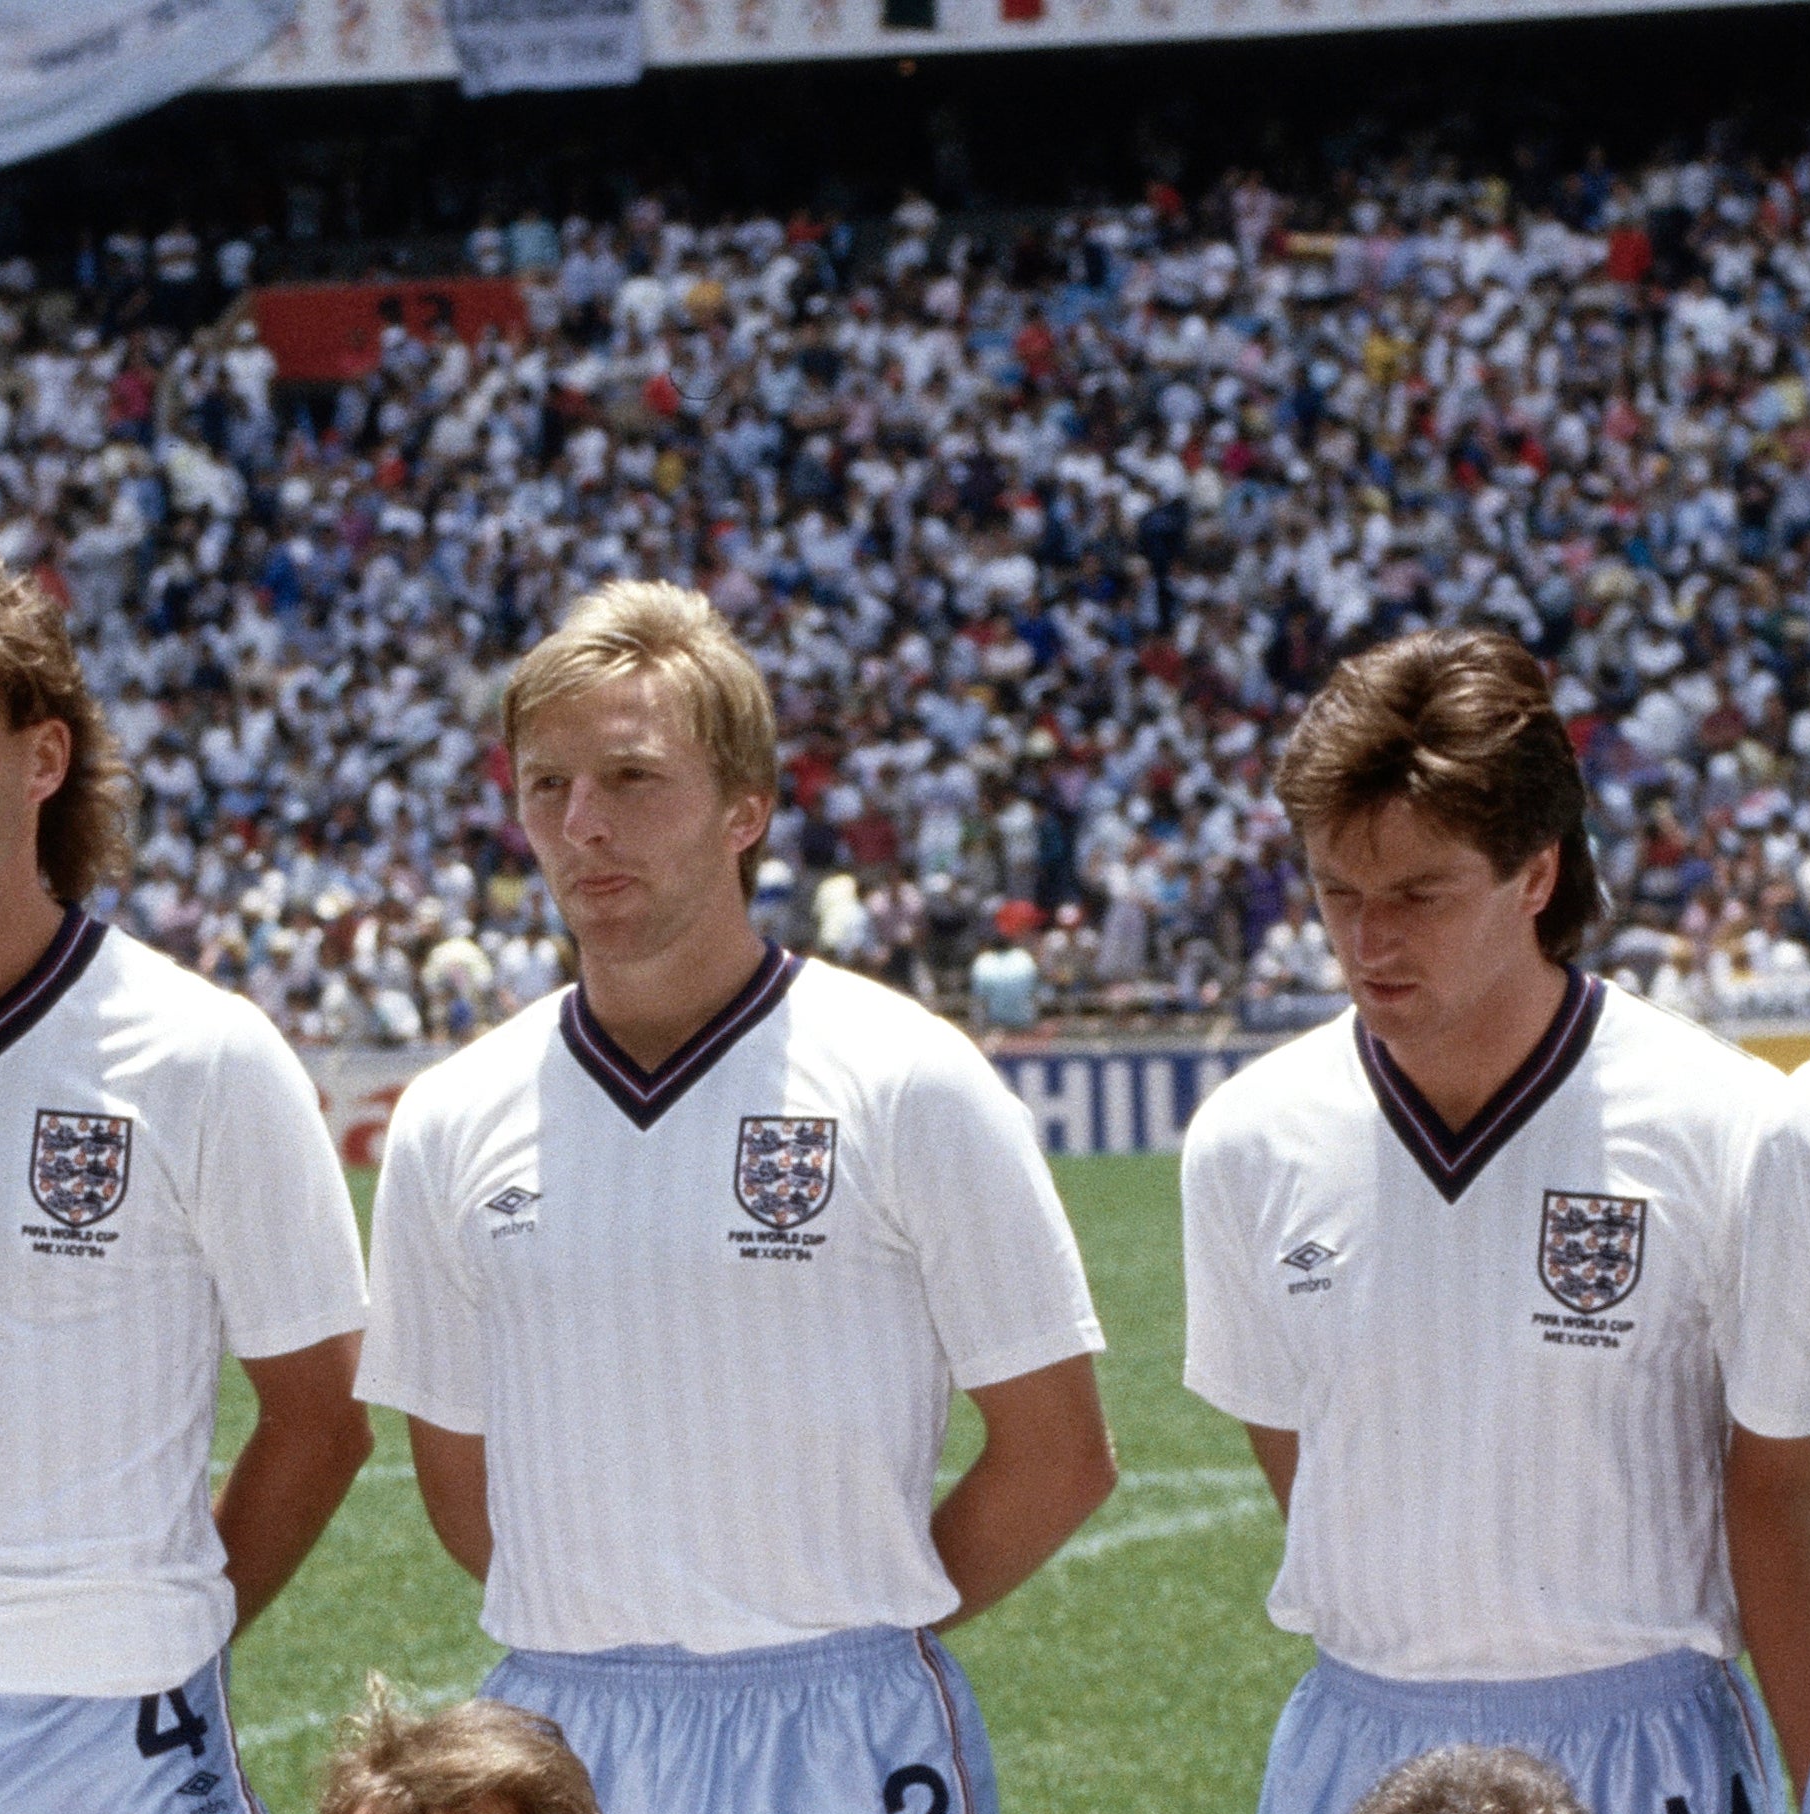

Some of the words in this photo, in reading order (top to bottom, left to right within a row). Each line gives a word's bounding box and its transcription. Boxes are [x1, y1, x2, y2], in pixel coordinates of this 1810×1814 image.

[22, 1225, 47, 1238] FIFA
[51, 1227, 93, 1242] WORLD
[95, 1231, 120, 1243] CUP
[728, 1230, 753, 1243] FIFA
[756, 1230, 800, 1245] WORLD
[802, 1233, 827, 1246] CUP
[1287, 1275, 1333, 1296] umbro
[1531, 1312, 1560, 1327] FIFA
[1562, 1315, 1608, 1330] WORLD
[1610, 1318, 1634, 1333] CUP
[135, 1686, 209, 1759] 4
